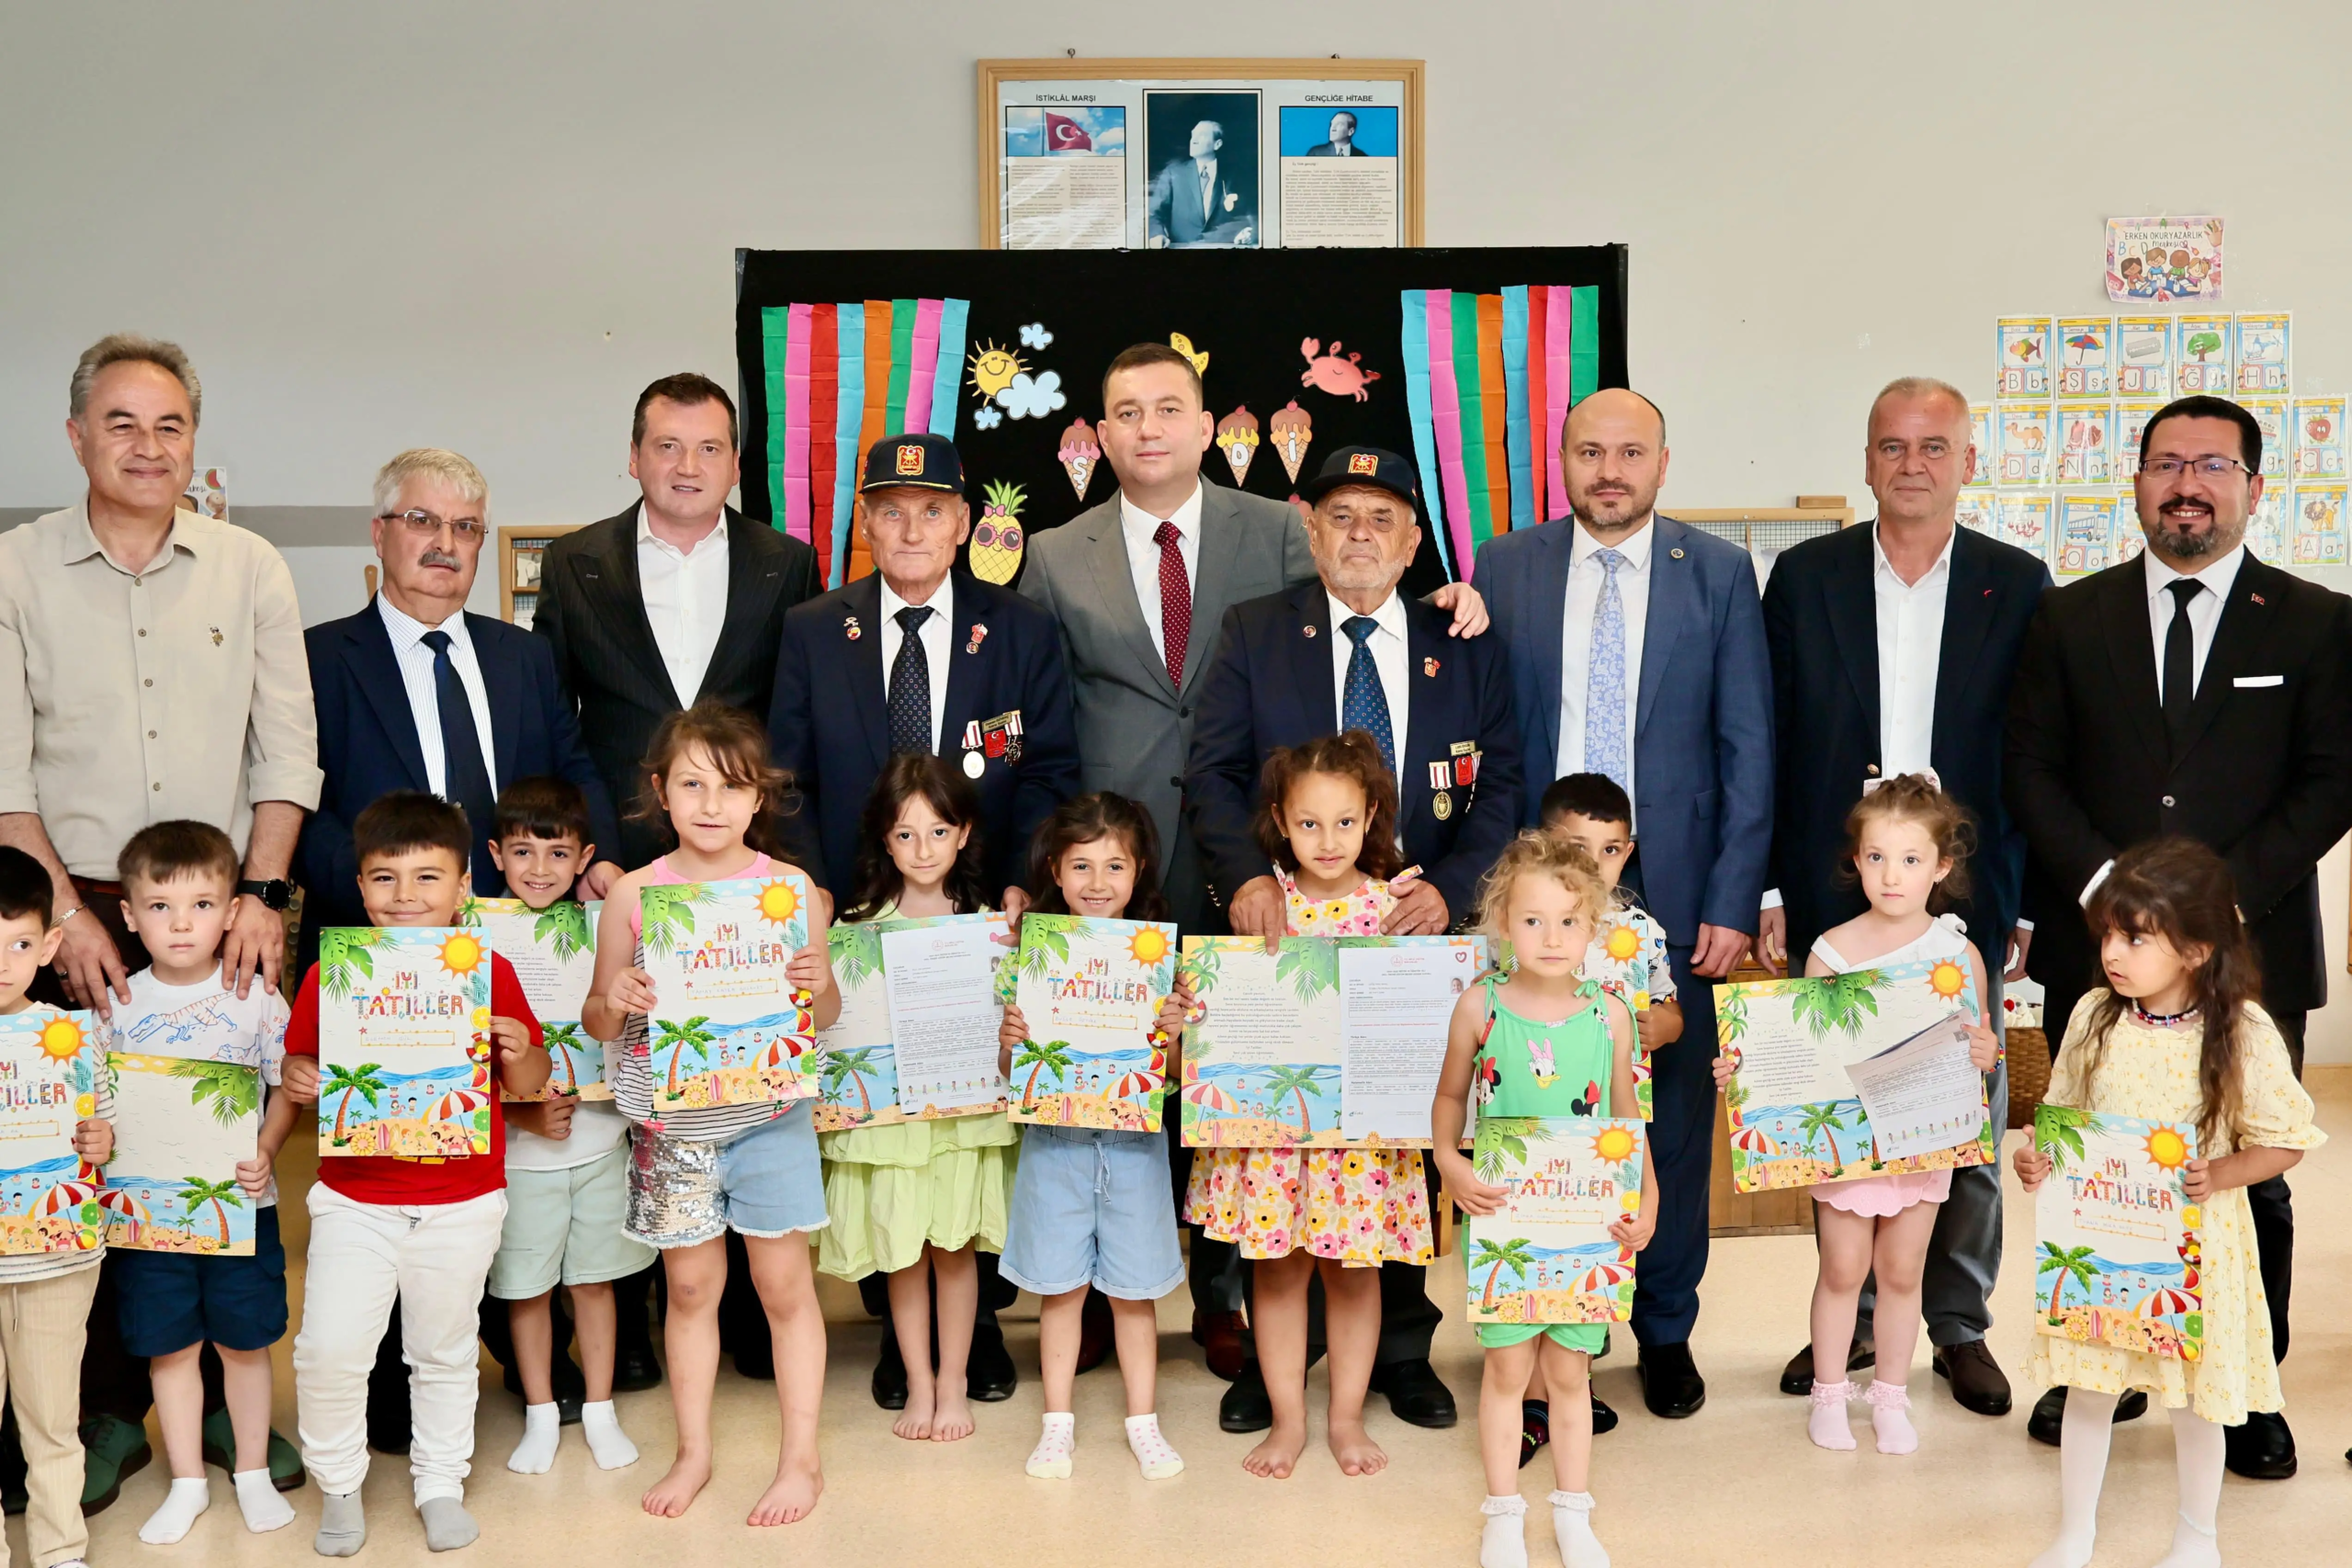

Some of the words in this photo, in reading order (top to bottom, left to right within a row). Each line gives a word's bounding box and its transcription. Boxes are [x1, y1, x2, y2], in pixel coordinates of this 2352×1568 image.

[1035, 94, 1069, 102] İSTİKLÂL
[1071, 95, 1096, 103] MARŞI
[1305, 95, 1343, 103] GENÇLİĞE
[2124, 231, 2148, 241] ERKEN
[2150, 231, 2203, 240] OKURYAZARLIK
[2008, 373, 2018, 389] B
[2030, 373, 2040, 389] b
[2070, 372, 2079, 390] Ş
[2091, 378, 2098, 389] ş
[2128, 371, 2137, 388] J
[2151, 370, 2157, 389] j
[2186, 368, 2199, 387] Ğ
[2246, 370, 2258, 385] H
[2268, 369, 2278, 384] h
[2008, 459, 2021, 476] D
[2031, 459, 2040, 474] d
[2067, 459, 2079, 474] N
[2090, 463, 2098, 474] n
[2126, 457, 2135, 472] T
[2303, 452, 2315, 471] Ç
[2326, 457, 2334, 468] ç
[2302, 539, 2314, 554] A
[2324, 545, 2334, 554] a
[2067, 550, 2081, 566] O
[2090, 557, 2099, 567] o
